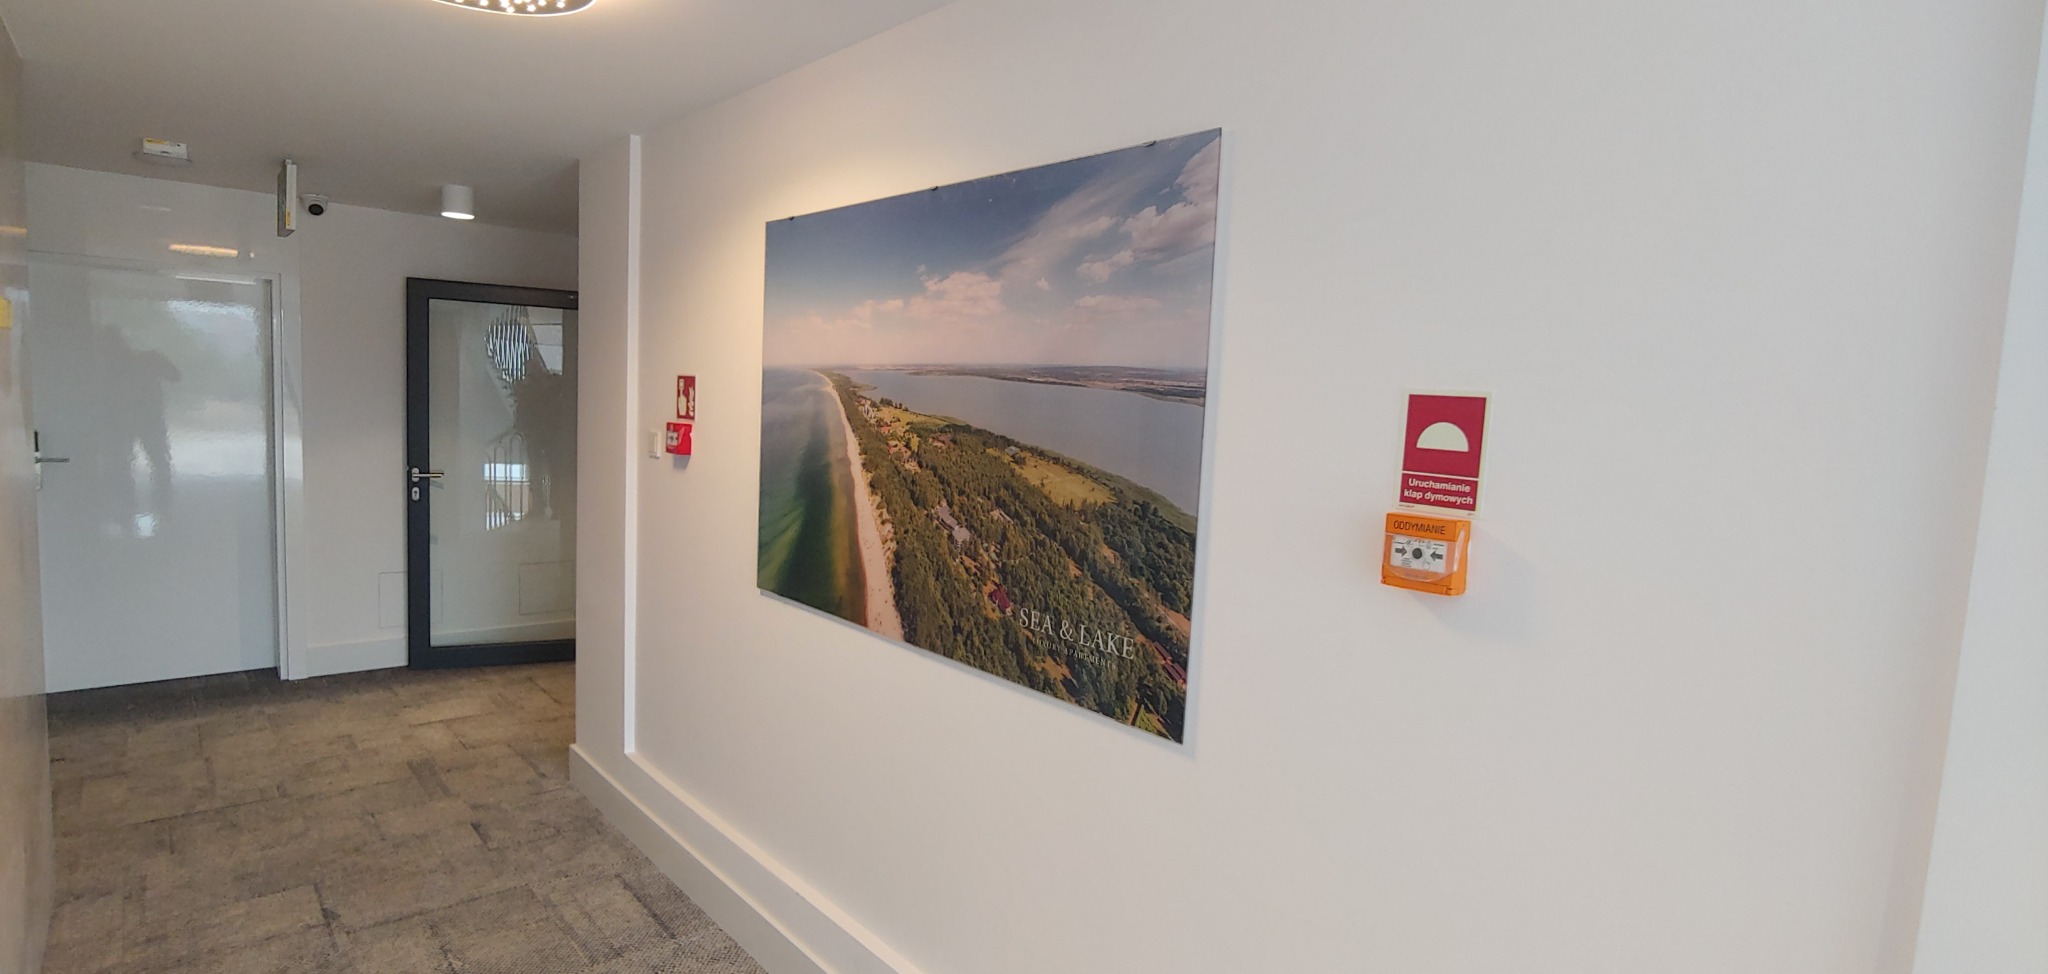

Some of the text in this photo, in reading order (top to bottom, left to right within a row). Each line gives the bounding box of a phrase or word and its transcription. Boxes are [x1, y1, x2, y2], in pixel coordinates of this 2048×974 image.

[1408, 478, 1471, 492] Uruchamianie
[1404, 488, 1473, 505] klap dymowych
[1393, 520, 1446, 535] ODDYMIANIE
[1020, 607, 1134, 660] SEA & LAKE
